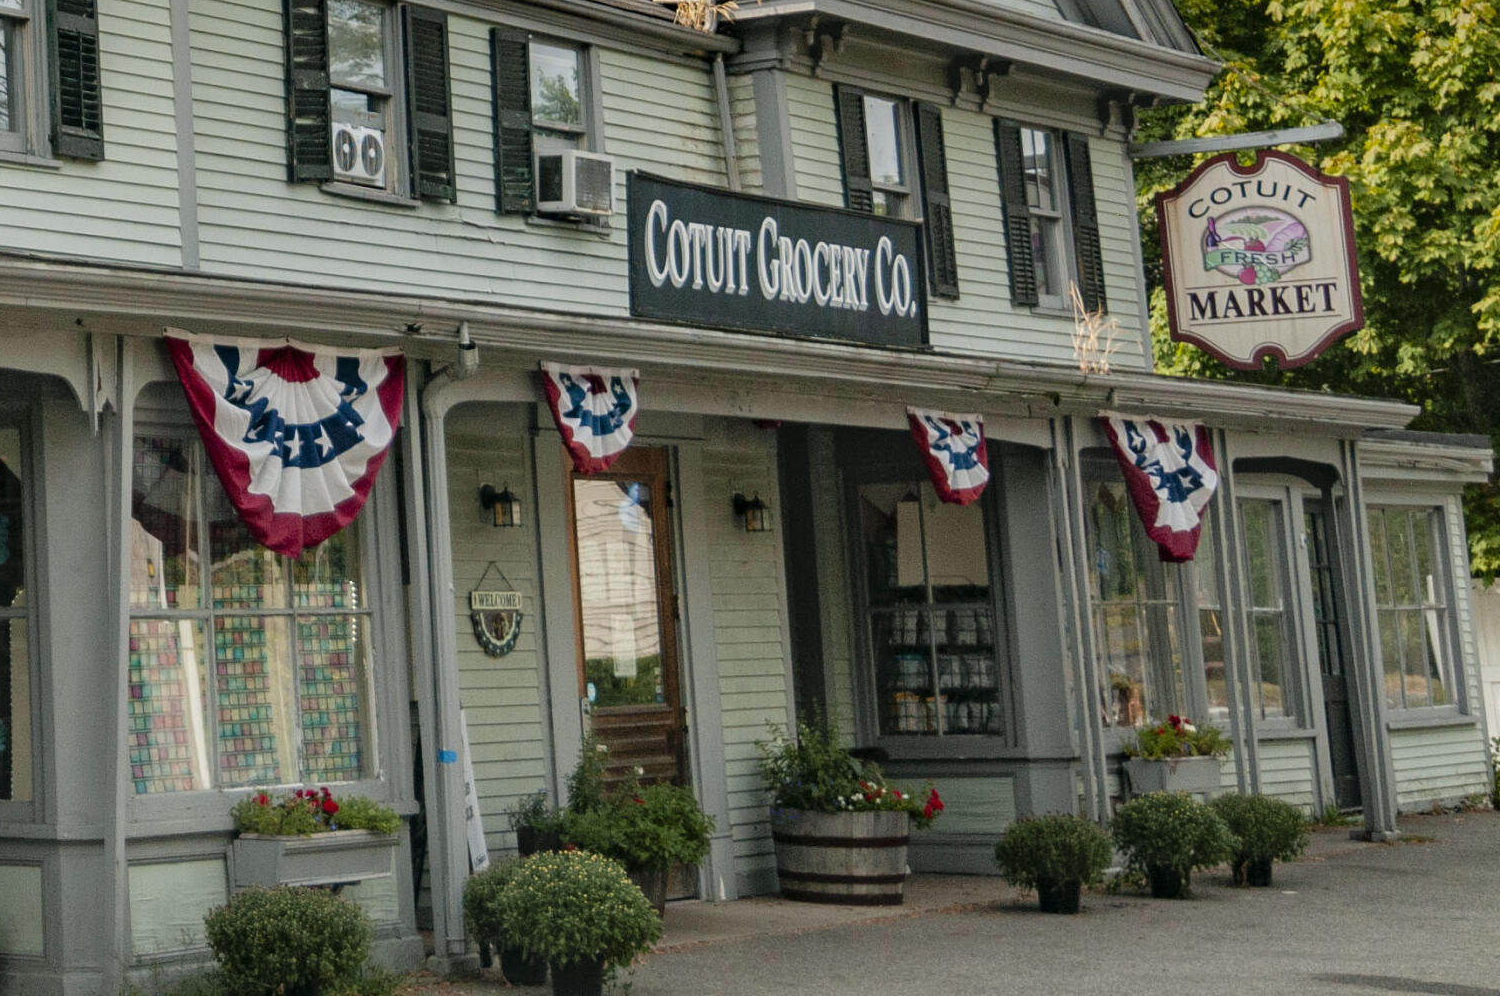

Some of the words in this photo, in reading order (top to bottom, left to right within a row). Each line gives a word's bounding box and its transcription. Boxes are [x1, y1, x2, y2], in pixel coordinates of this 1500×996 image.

[1188, 179, 1317, 219] COTUIT
[1220, 250, 1296, 265] FRESH
[1186, 282, 1338, 322] MARKET
[478, 593, 517, 607] WELCOME
